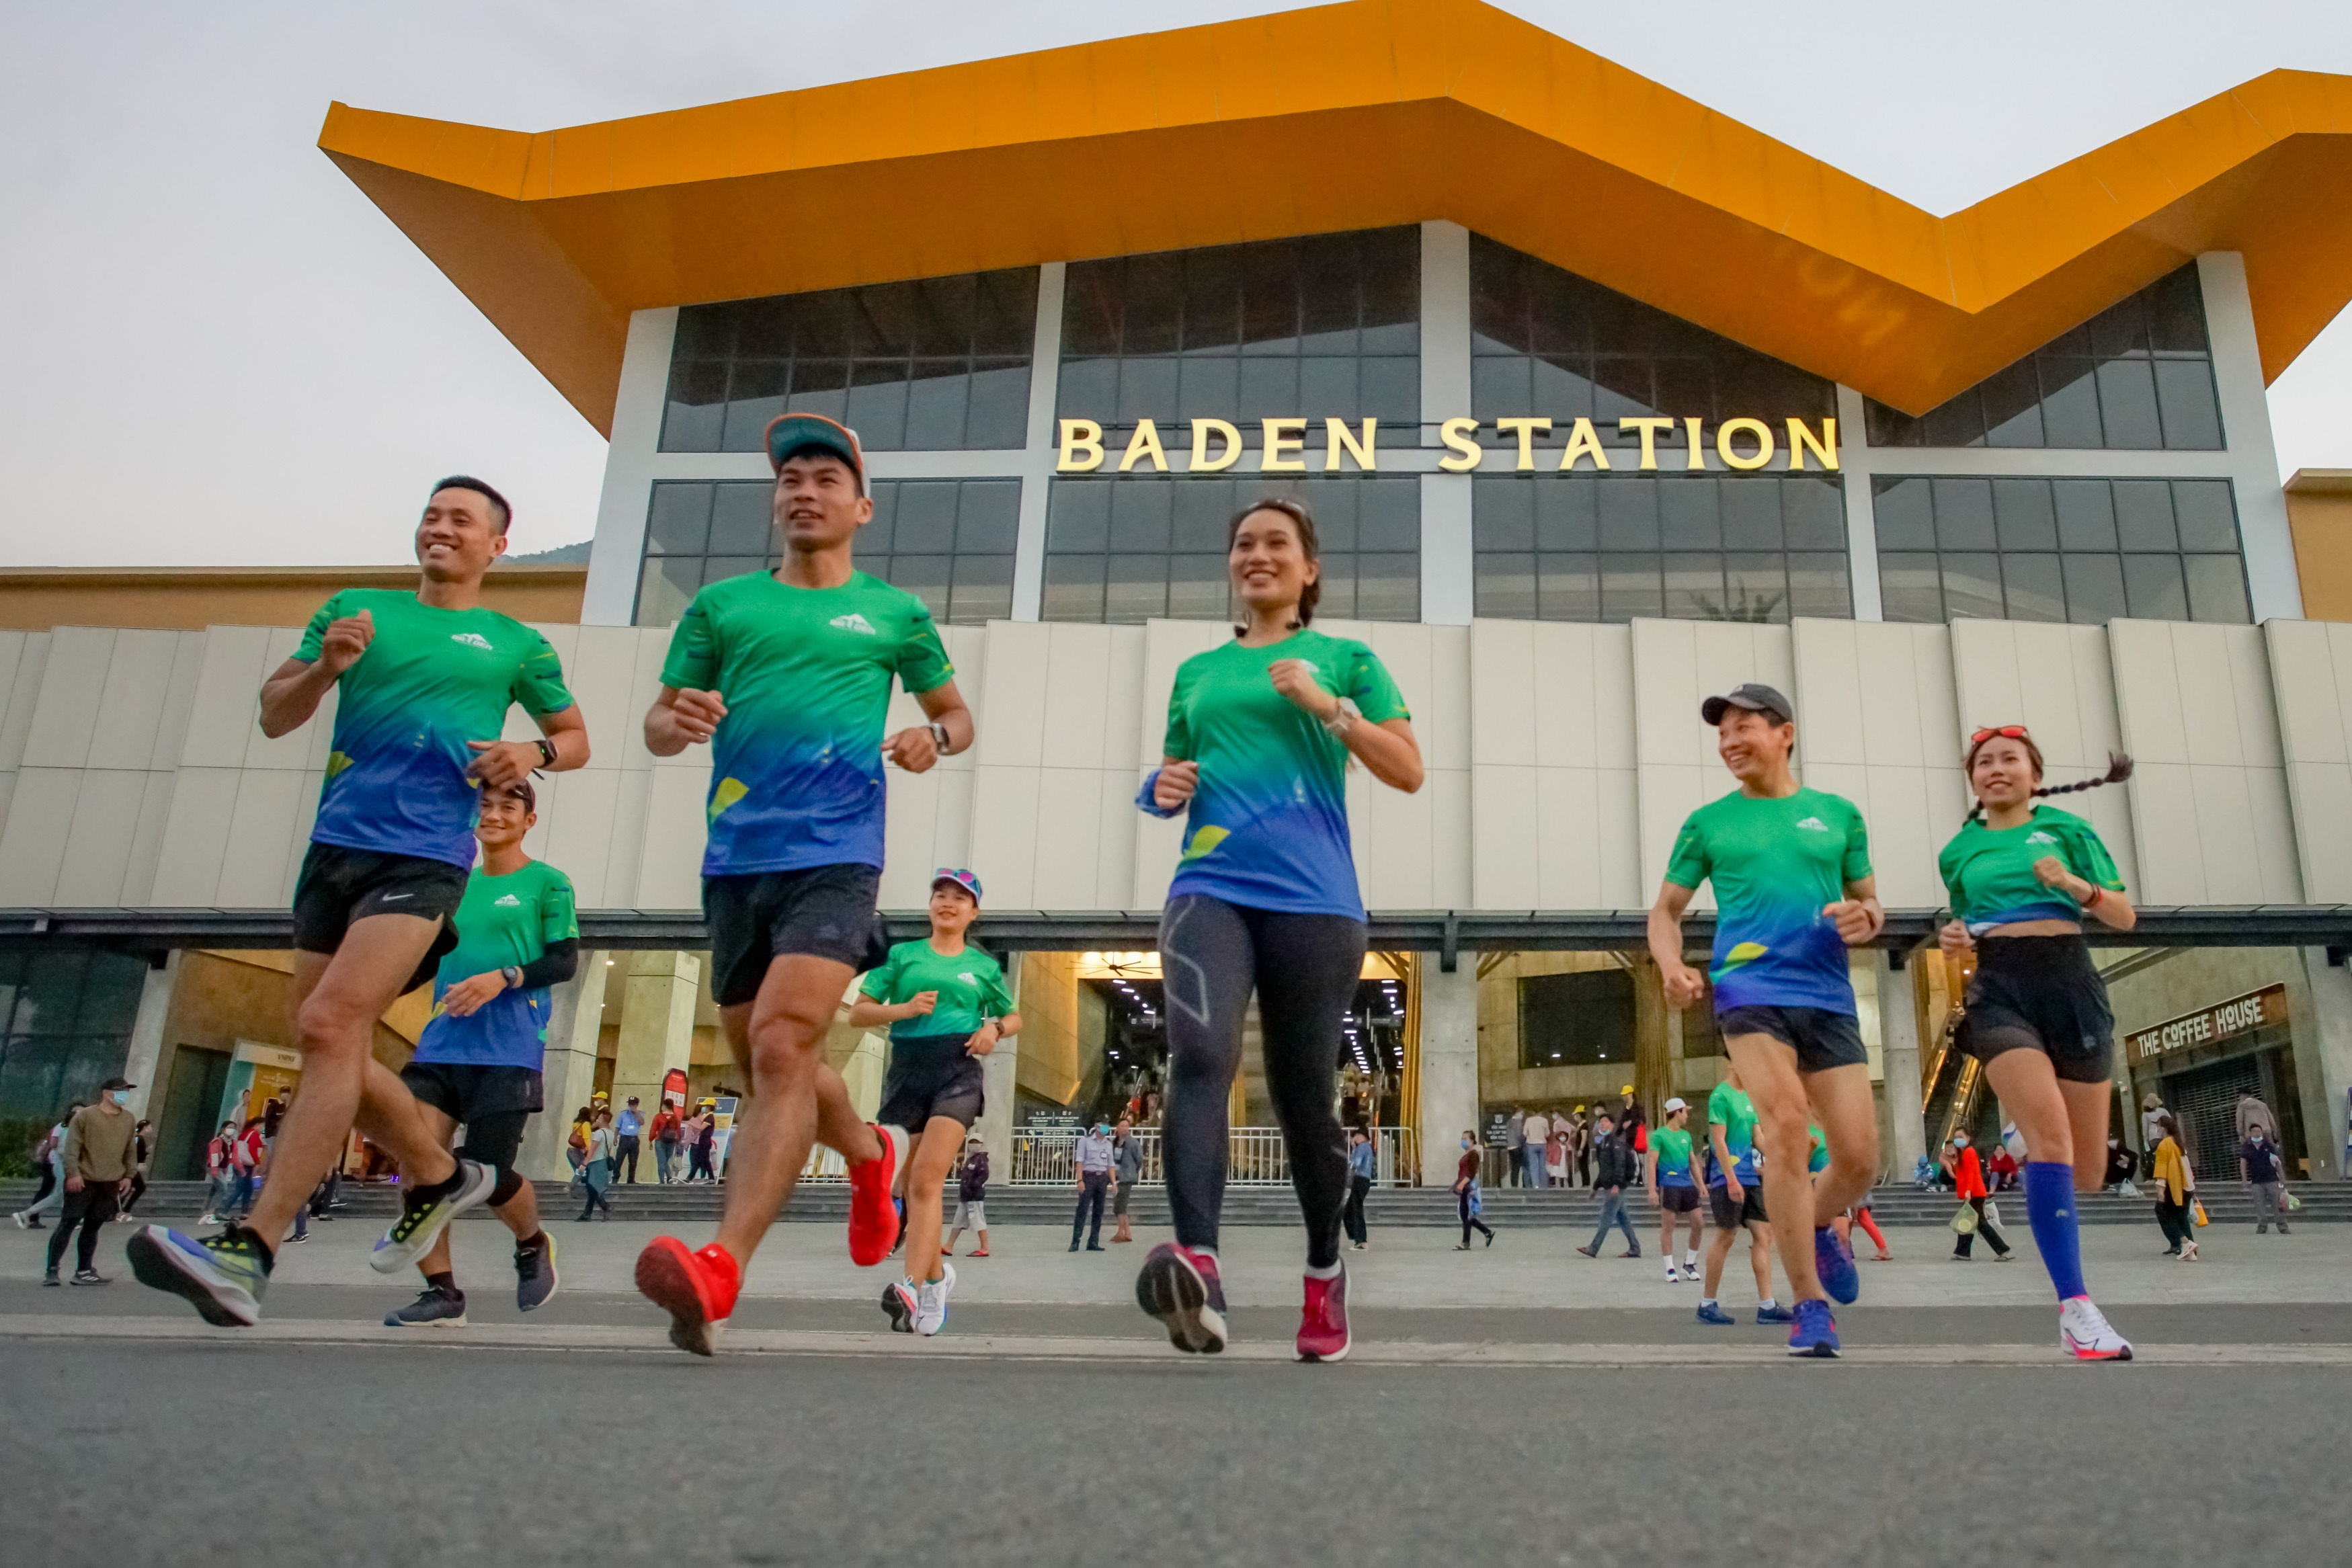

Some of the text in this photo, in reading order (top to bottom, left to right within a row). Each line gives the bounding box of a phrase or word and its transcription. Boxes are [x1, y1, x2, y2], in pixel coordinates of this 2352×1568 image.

[1056, 417, 1840, 473] BADEN STATION
[2137, 996, 2264, 1058] THE COFFEE HOUSE
